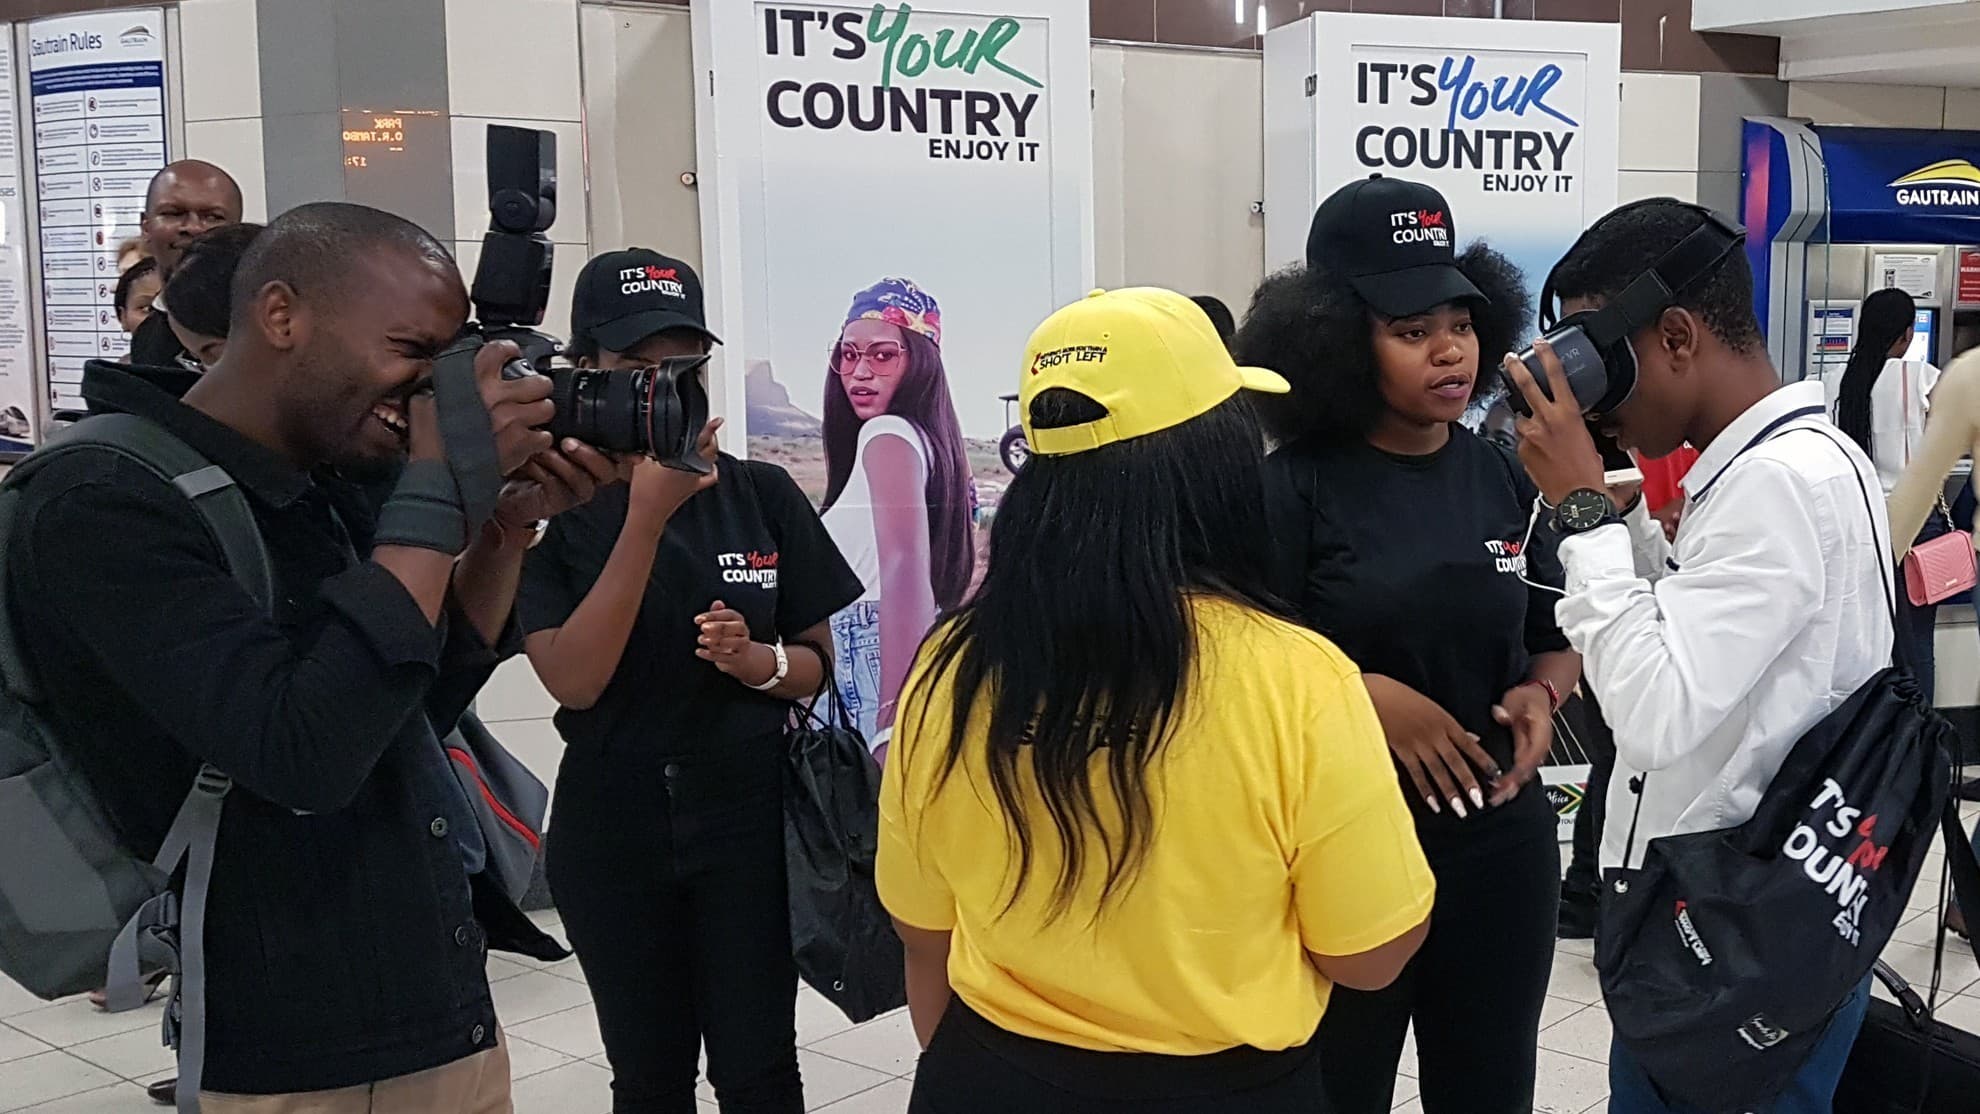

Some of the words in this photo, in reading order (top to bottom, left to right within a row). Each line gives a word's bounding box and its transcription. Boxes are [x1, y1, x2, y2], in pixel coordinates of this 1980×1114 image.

[70, 31, 102, 51] Rules
[764, 8, 867, 60] IT'S
[1357, 62, 1438, 107] IT'S
[766, 80, 1039, 138] COUNTRY
[928, 138, 1010, 161] ENJOY
[1017, 142, 1040, 162] IT
[1355, 125, 1575, 172] COUNTRY
[1482, 174, 1549, 192] ENJOY
[1555, 175, 1574, 192] IT
[1896, 189, 1979, 206] GAUTRAIN
[1390, 211, 1418, 226] IT'S
[1393, 227, 1448, 244] COUNTRY
[620, 267, 646, 281] IT'S
[621, 280, 683, 295] COUNTRY
[1076, 351, 1107, 363] LEFT
[717, 552, 746, 567] IT'S
[722, 568, 778, 583] COUNTRY
